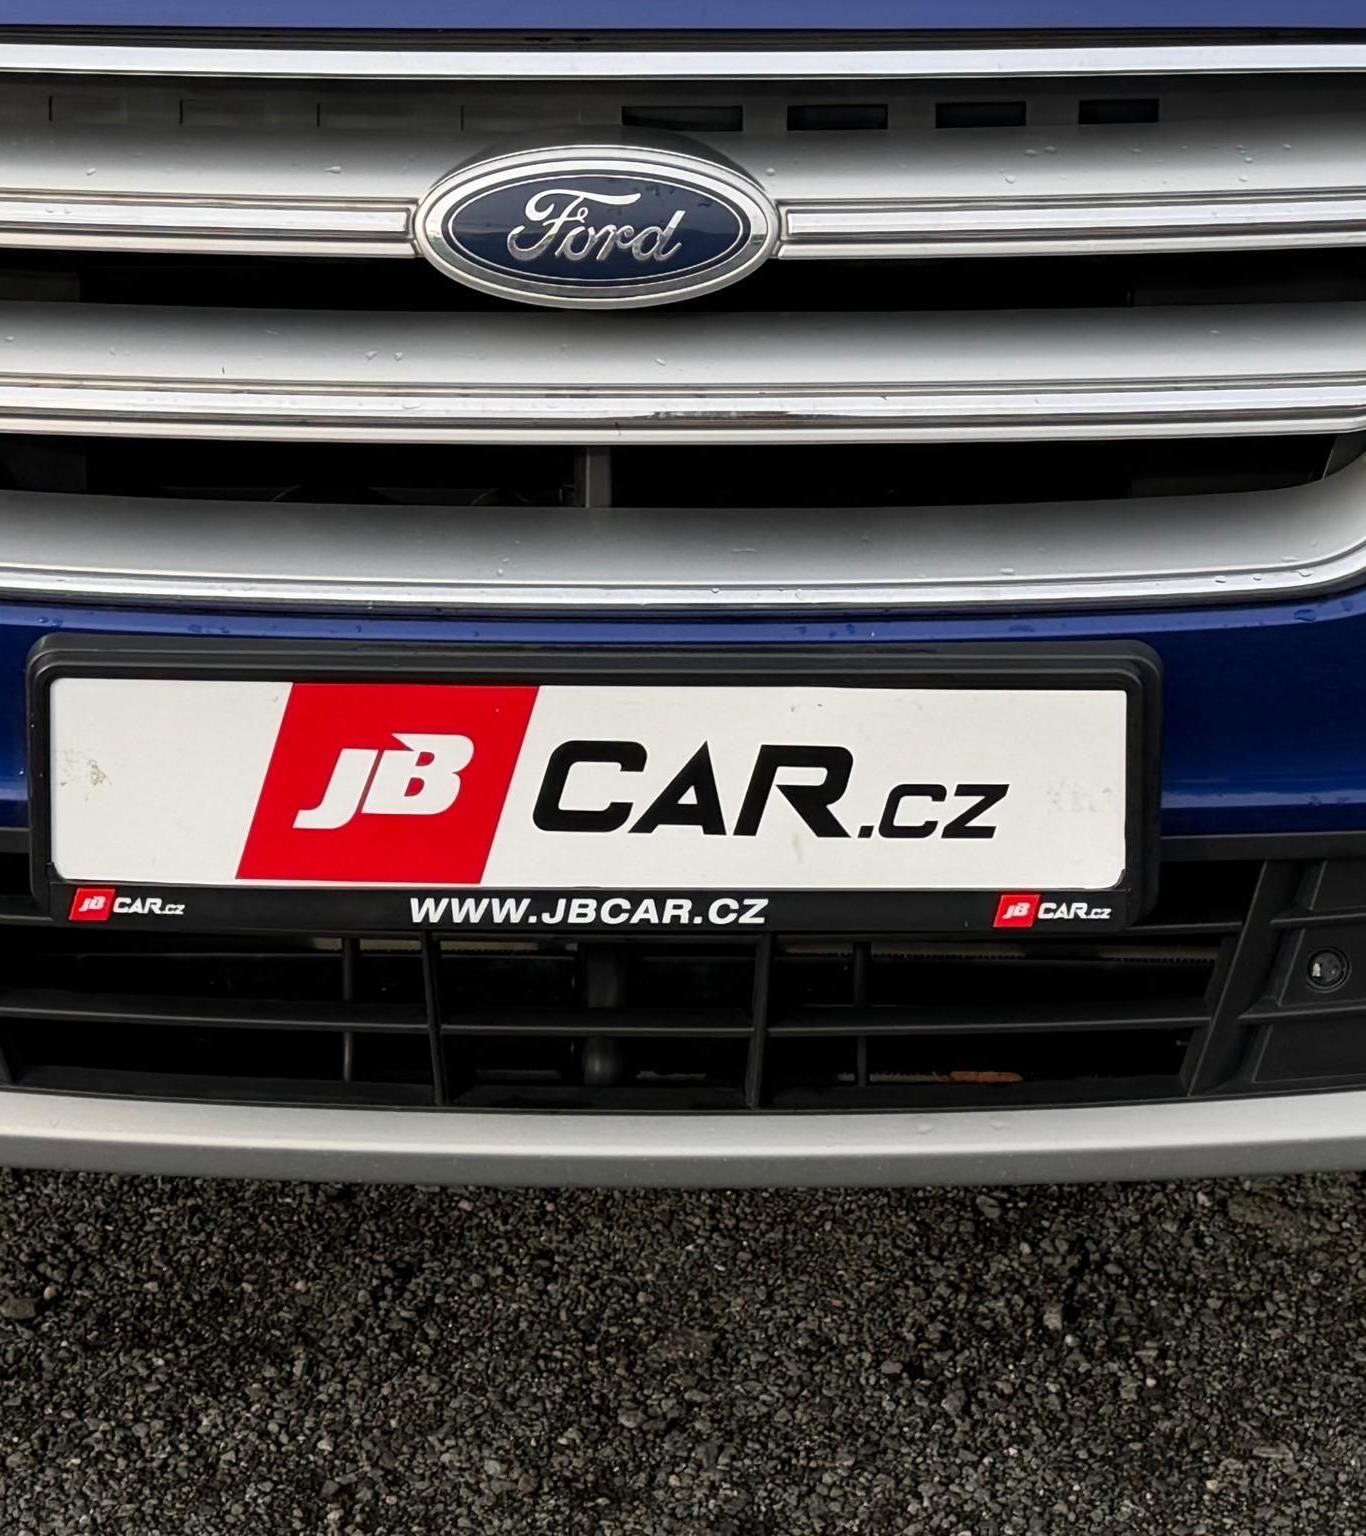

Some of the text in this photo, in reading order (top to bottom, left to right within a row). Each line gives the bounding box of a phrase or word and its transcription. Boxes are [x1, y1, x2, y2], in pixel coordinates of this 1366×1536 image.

[507, 189, 686, 262] Ford
[292, 733, 475, 830] JB
[78, 896, 106, 912] JB
[409, 897, 769, 924] WWW.JBCAR.CZ
[1002, 902, 1030, 919] JB
